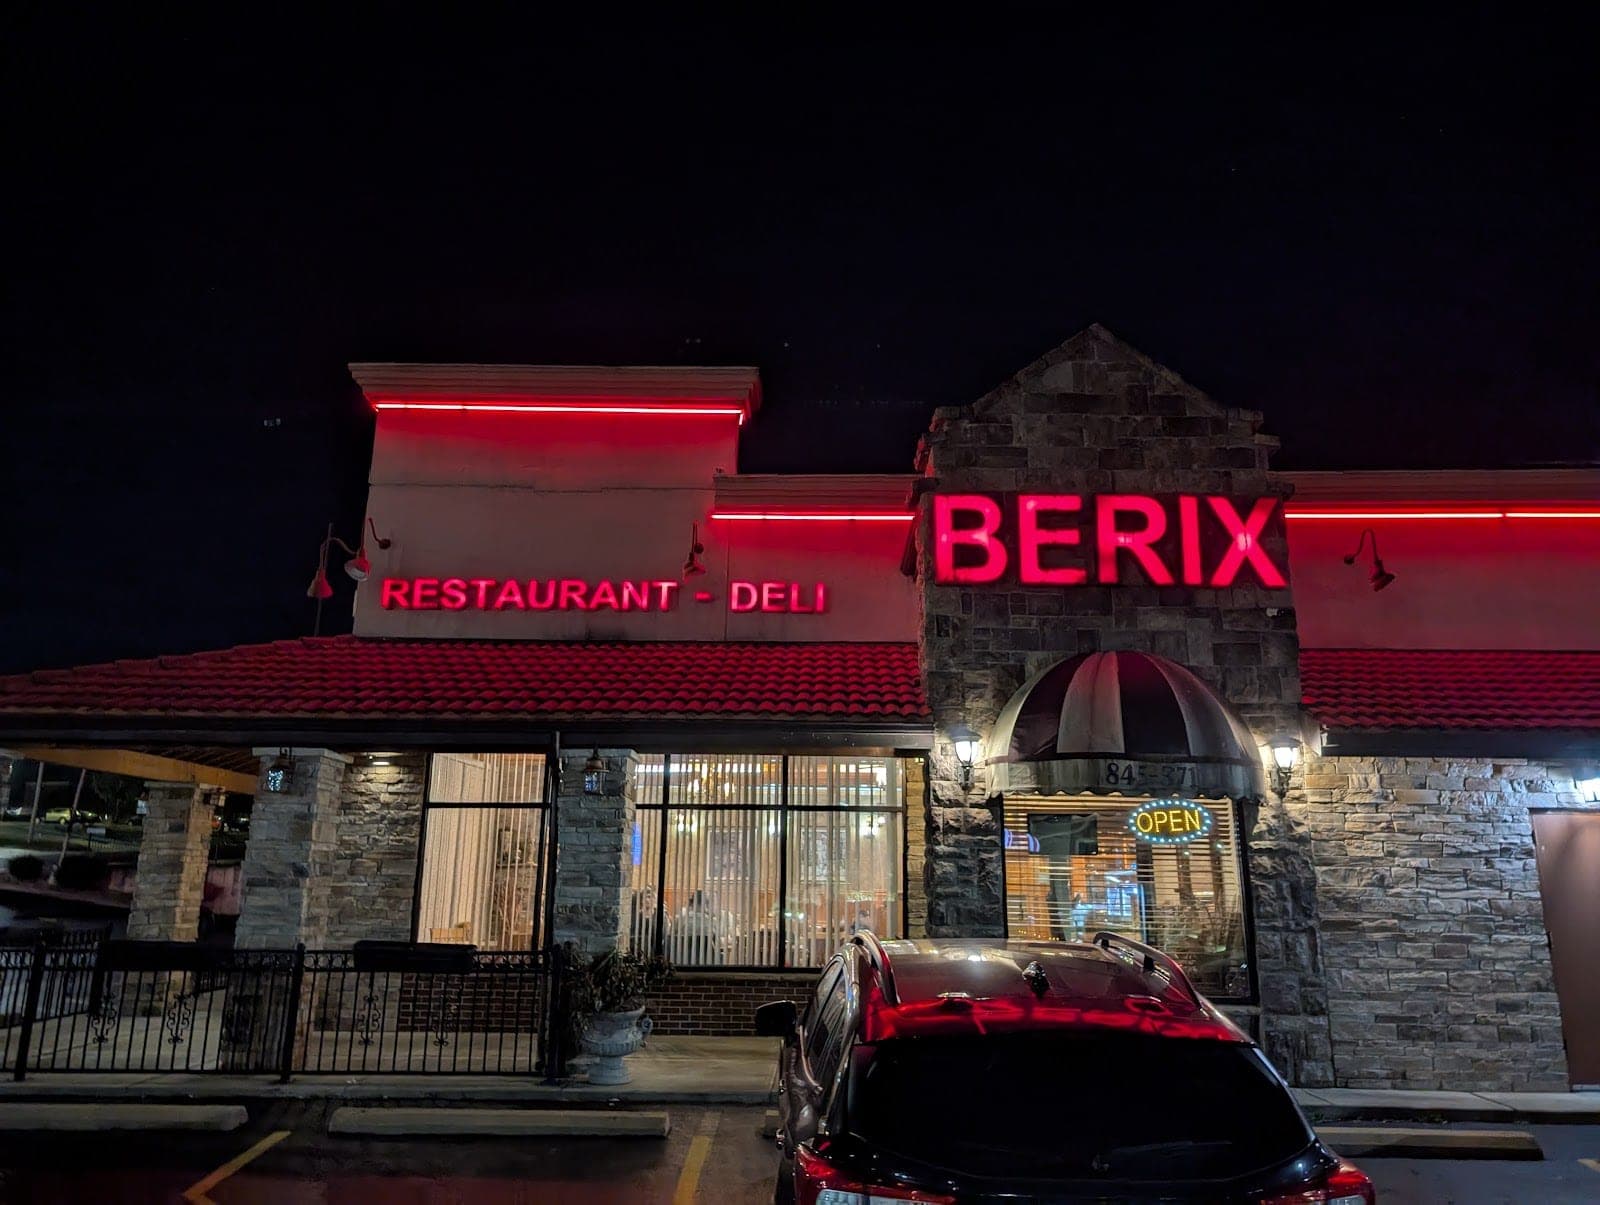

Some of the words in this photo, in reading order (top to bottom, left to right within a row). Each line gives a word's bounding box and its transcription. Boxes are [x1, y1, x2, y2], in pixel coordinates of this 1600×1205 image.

[933, 493, 1287, 588] BERIX
[380, 577, 679, 612] RESTAURANT
[729, 580, 827, 614] DELI
[1136, 809, 1201, 834] OPEN
